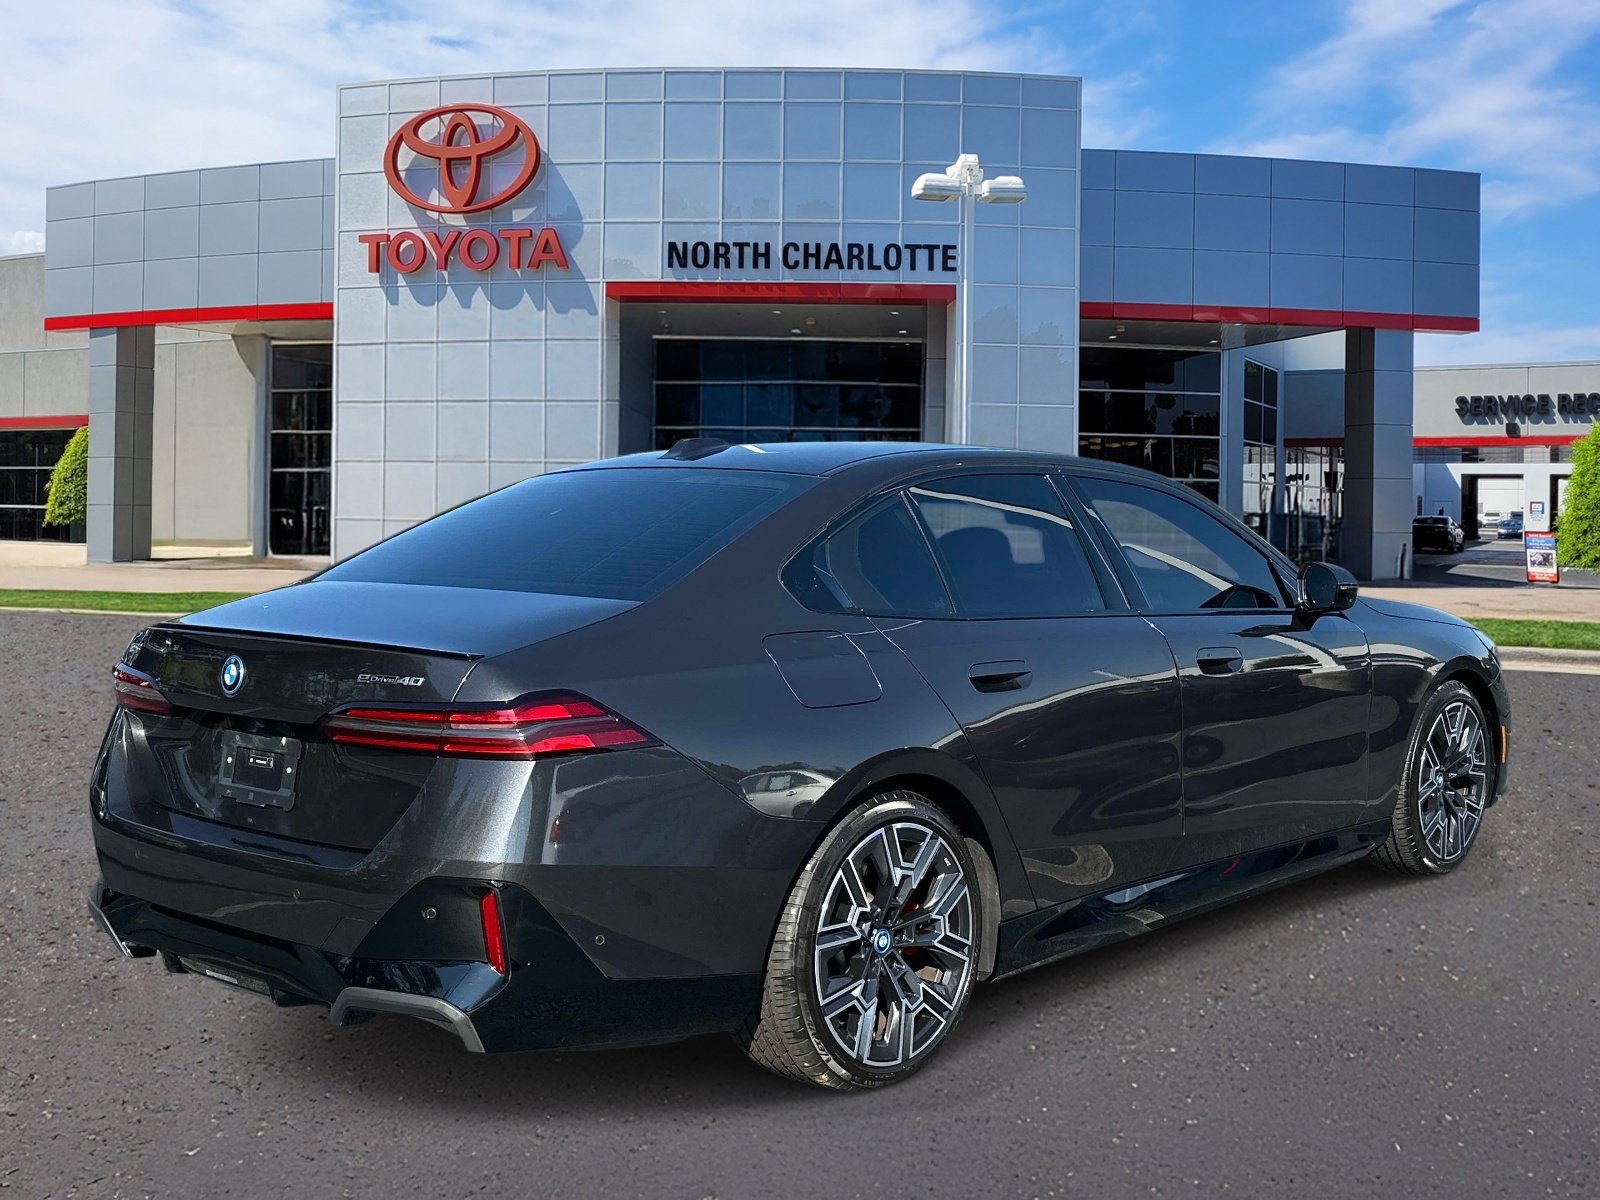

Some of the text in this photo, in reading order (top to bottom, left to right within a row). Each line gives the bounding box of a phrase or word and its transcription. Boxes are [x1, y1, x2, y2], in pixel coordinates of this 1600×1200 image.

[359, 228, 569, 274] TOYOTA
[667, 241, 957, 271] NORTH CHARLOTTE
[1455, 394, 1550, 416] SERVICE
